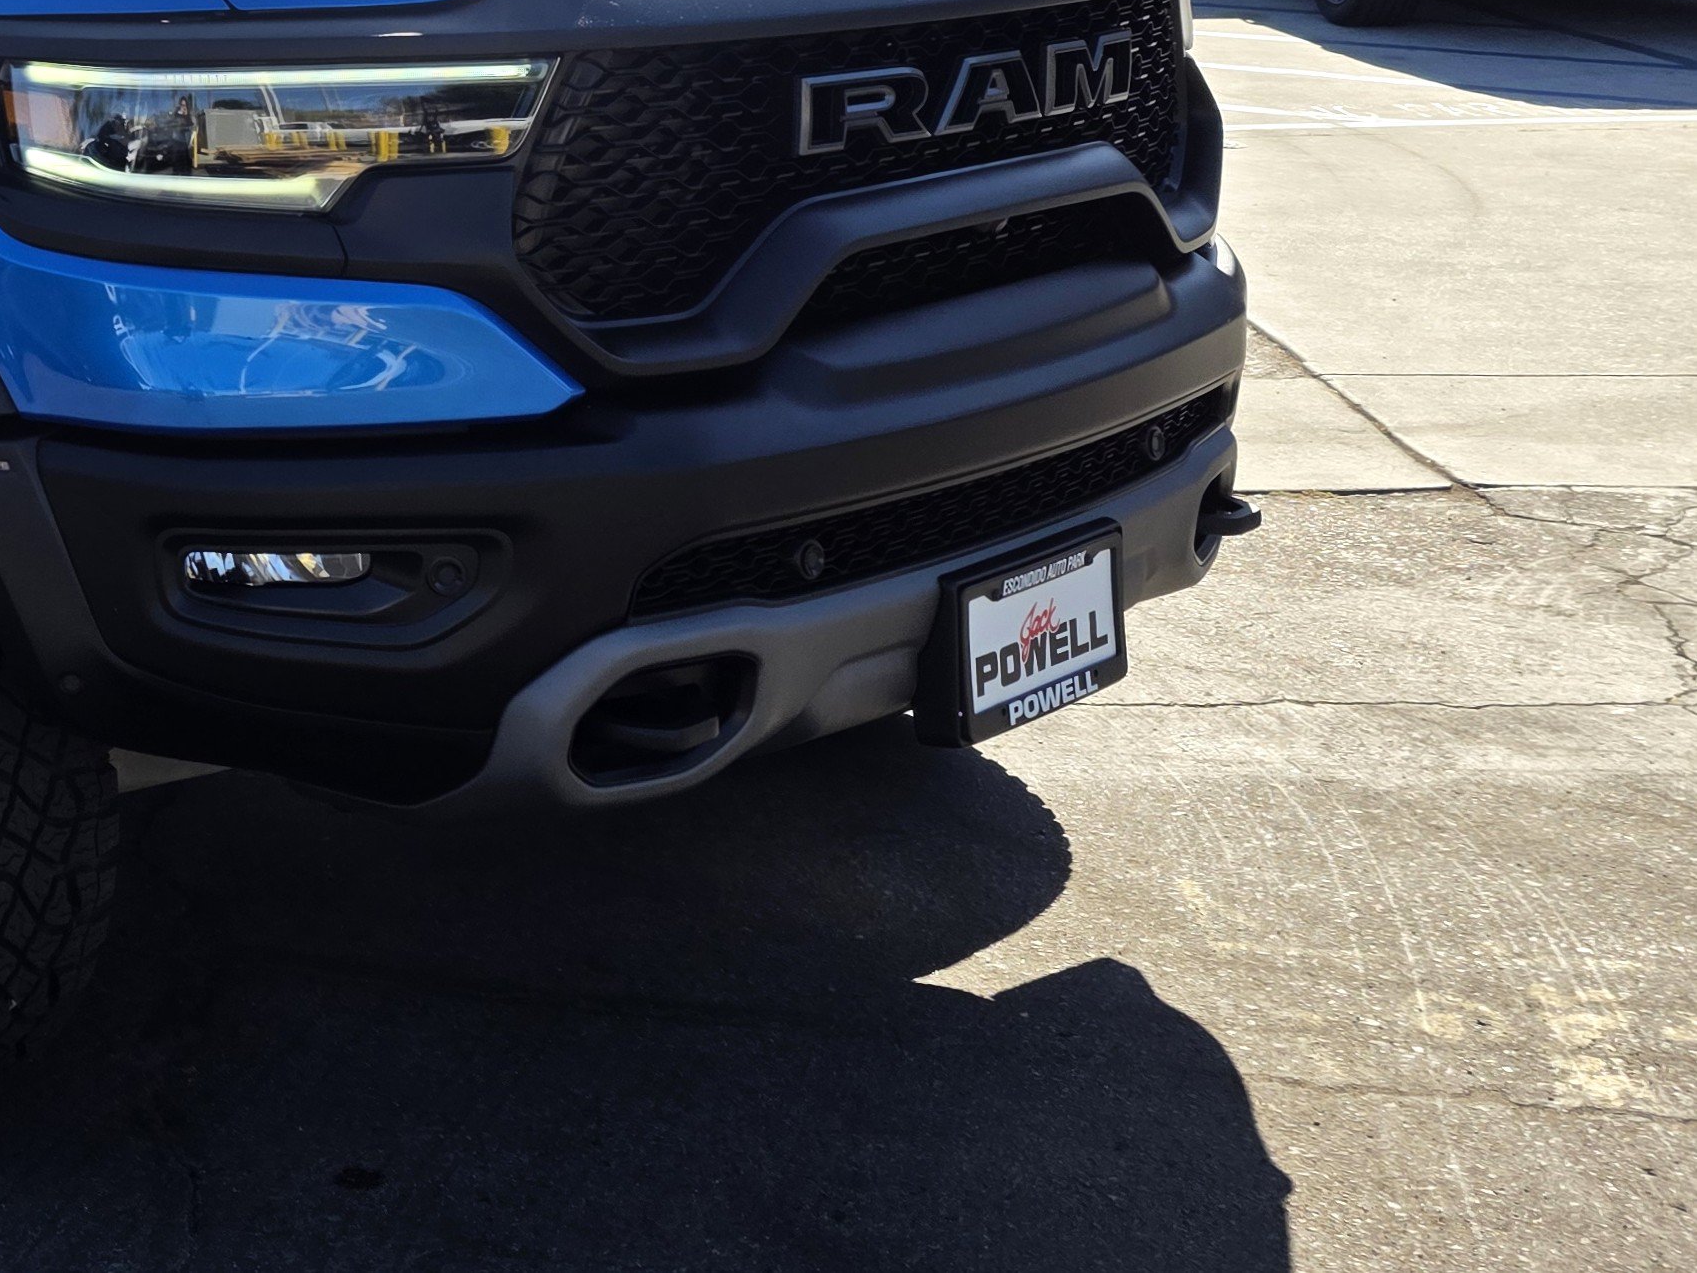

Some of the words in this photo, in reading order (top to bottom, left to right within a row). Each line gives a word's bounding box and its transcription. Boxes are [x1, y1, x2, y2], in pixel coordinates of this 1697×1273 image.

[798, 28, 1132, 156] RAM
[1002, 566, 1047, 597] ESCONDIDO
[1047, 559, 1067, 580] AUTO
[1067, 550, 1087, 572] PARK
[975, 610, 1109, 697] POWELL
[1019, 598, 1059, 662] Jack
[1008, 670, 1099, 726] POWELL
